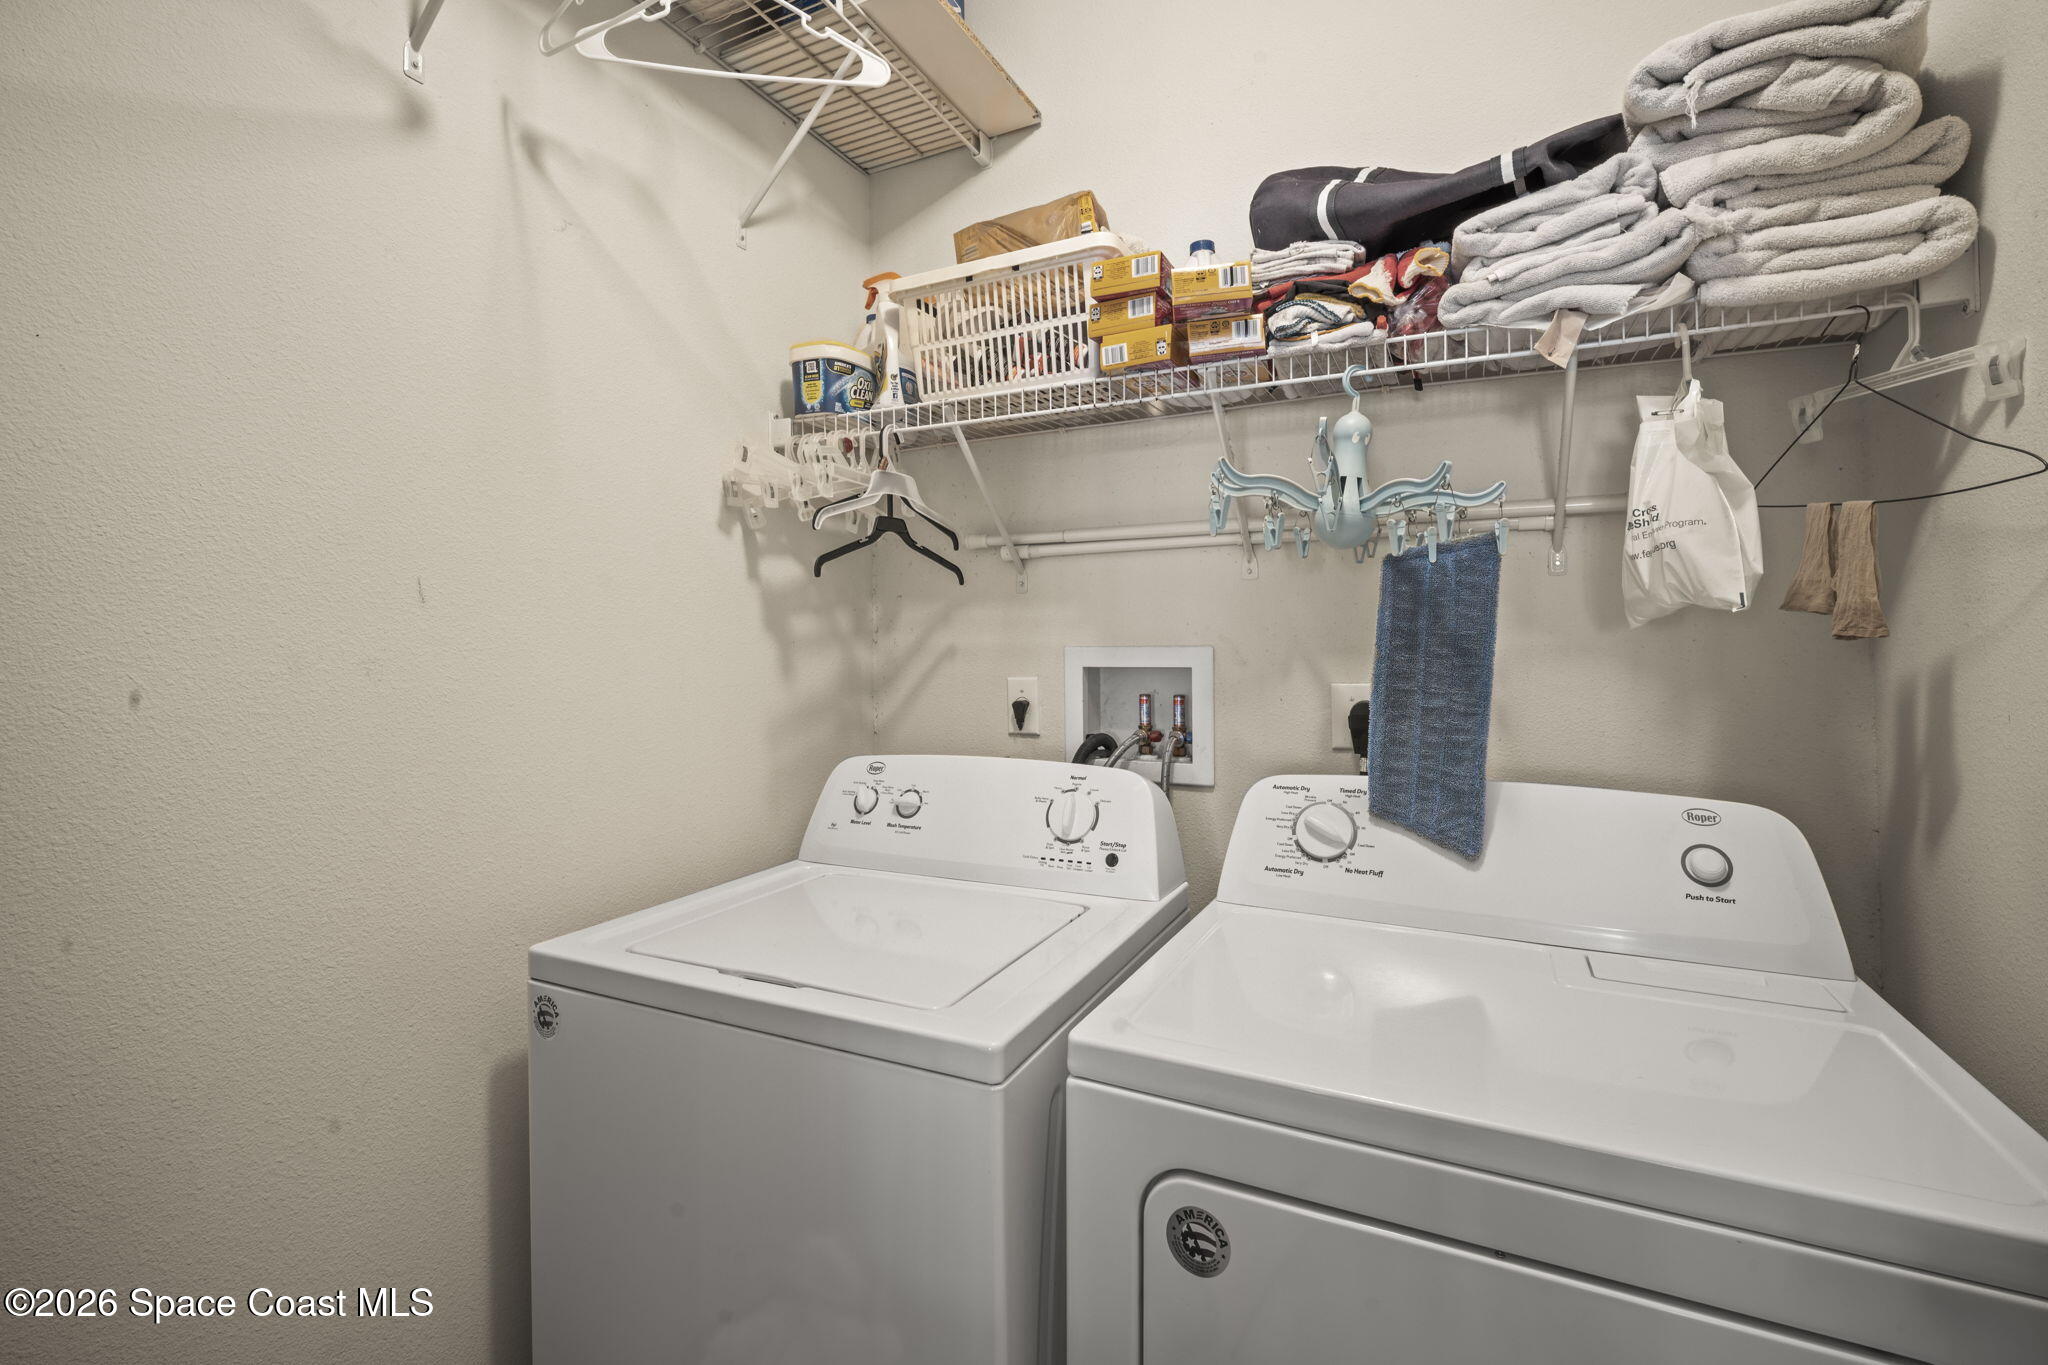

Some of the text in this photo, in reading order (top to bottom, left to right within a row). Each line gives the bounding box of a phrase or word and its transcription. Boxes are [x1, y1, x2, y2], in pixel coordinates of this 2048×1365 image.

[850, 385, 874, 401] CLEAN
[868, 764, 884, 773] Roper
[1686, 812, 1718, 823] Roper
[898, 823, 922, 831] Temperature
[1100, 841, 1127, 849] Start/Stop
[1264, 865, 1304, 876] Automatic Dry
[1369, 869, 1384, 877] Fluff
[1685, 893, 1704, 901] Push
[1715, 895, 1736, 904] Start
[534, 995, 559, 1018] AMERICA
[1175, 1209, 1228, 1249] AMERICA
